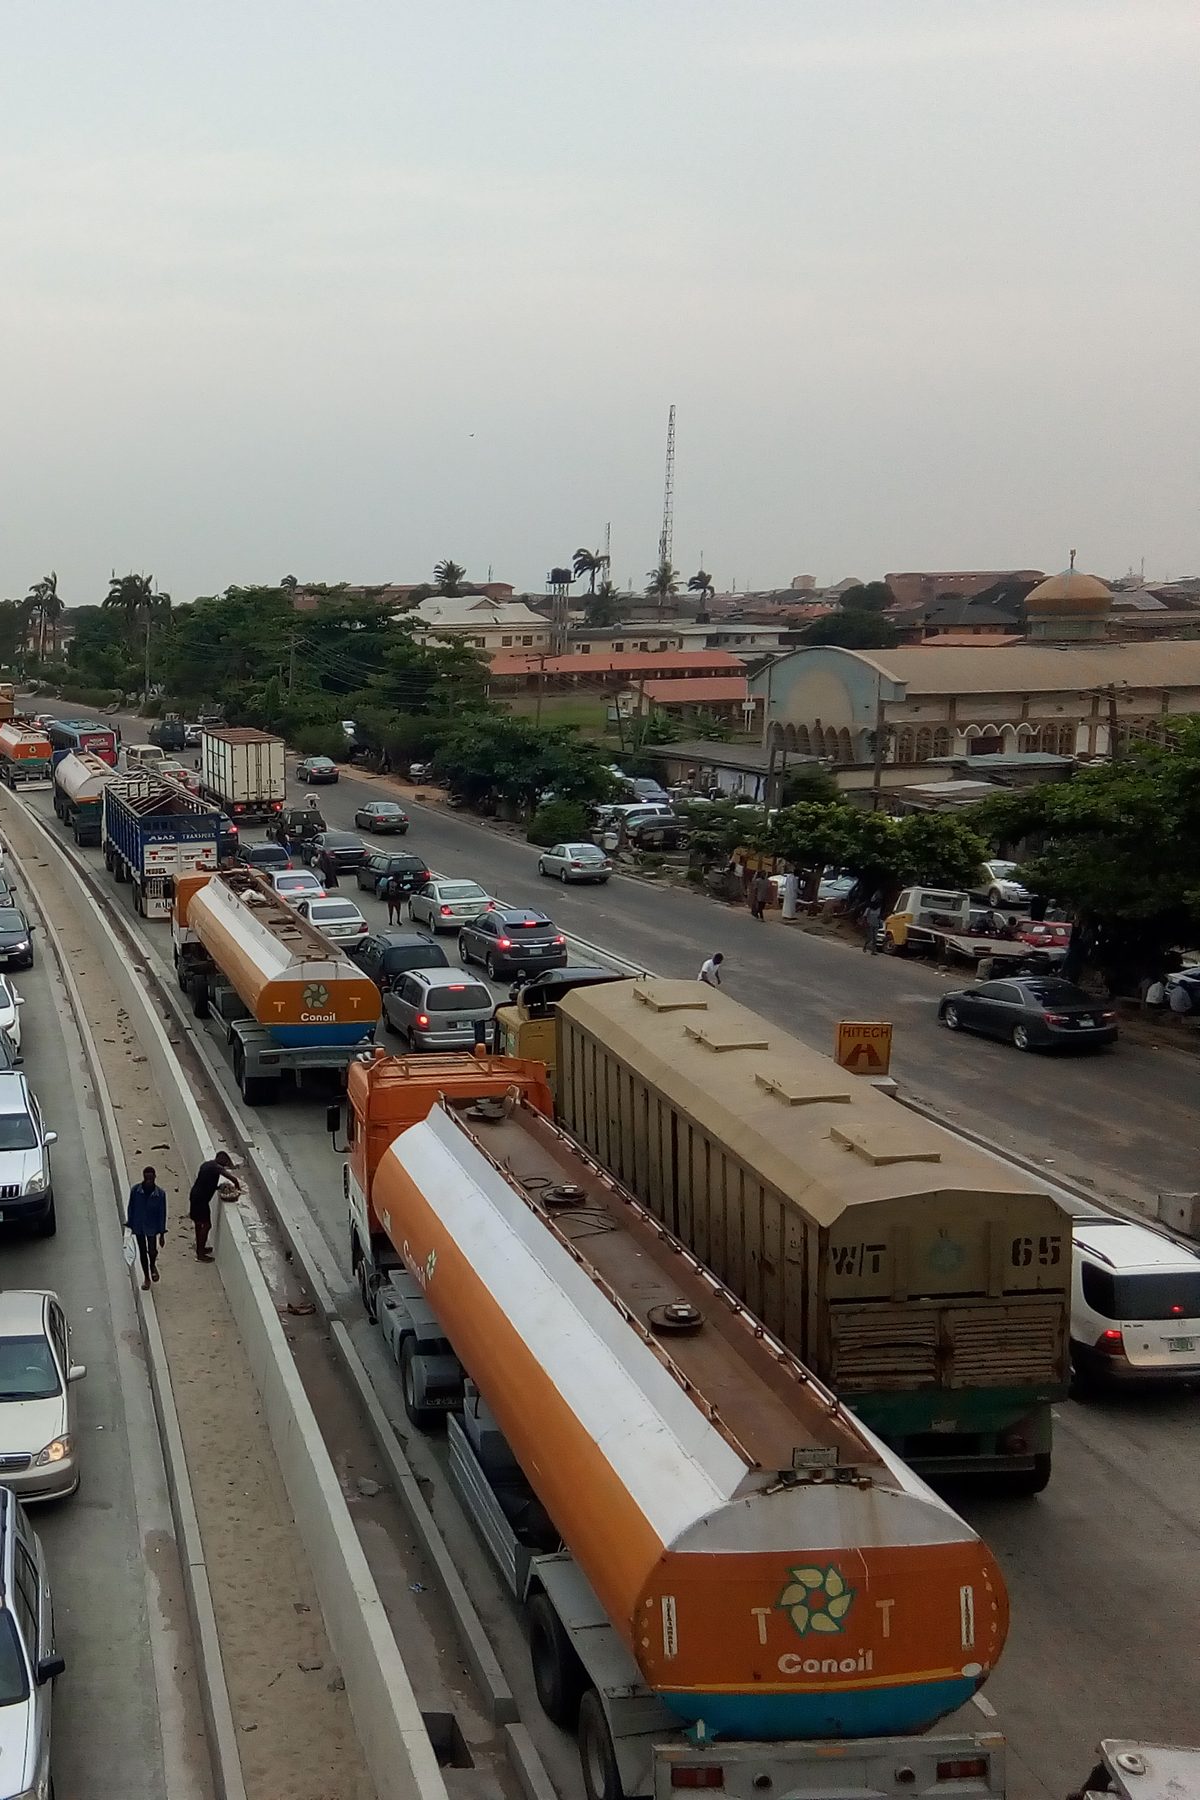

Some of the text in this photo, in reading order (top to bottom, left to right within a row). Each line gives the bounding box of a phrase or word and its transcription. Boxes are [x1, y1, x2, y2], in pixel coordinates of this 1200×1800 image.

[273, 1001, 286, 1013] T
[349, 997, 362, 1008] T
[300, 1012, 336, 1022] Conoil
[843, 1027, 889, 1038] HITECH
[1011, 1236, 1062, 1267] 65
[751, 1607, 772, 1645] T
[875, 1599, 895, 1638] T
[777, 1648, 874, 1674] Conoil
